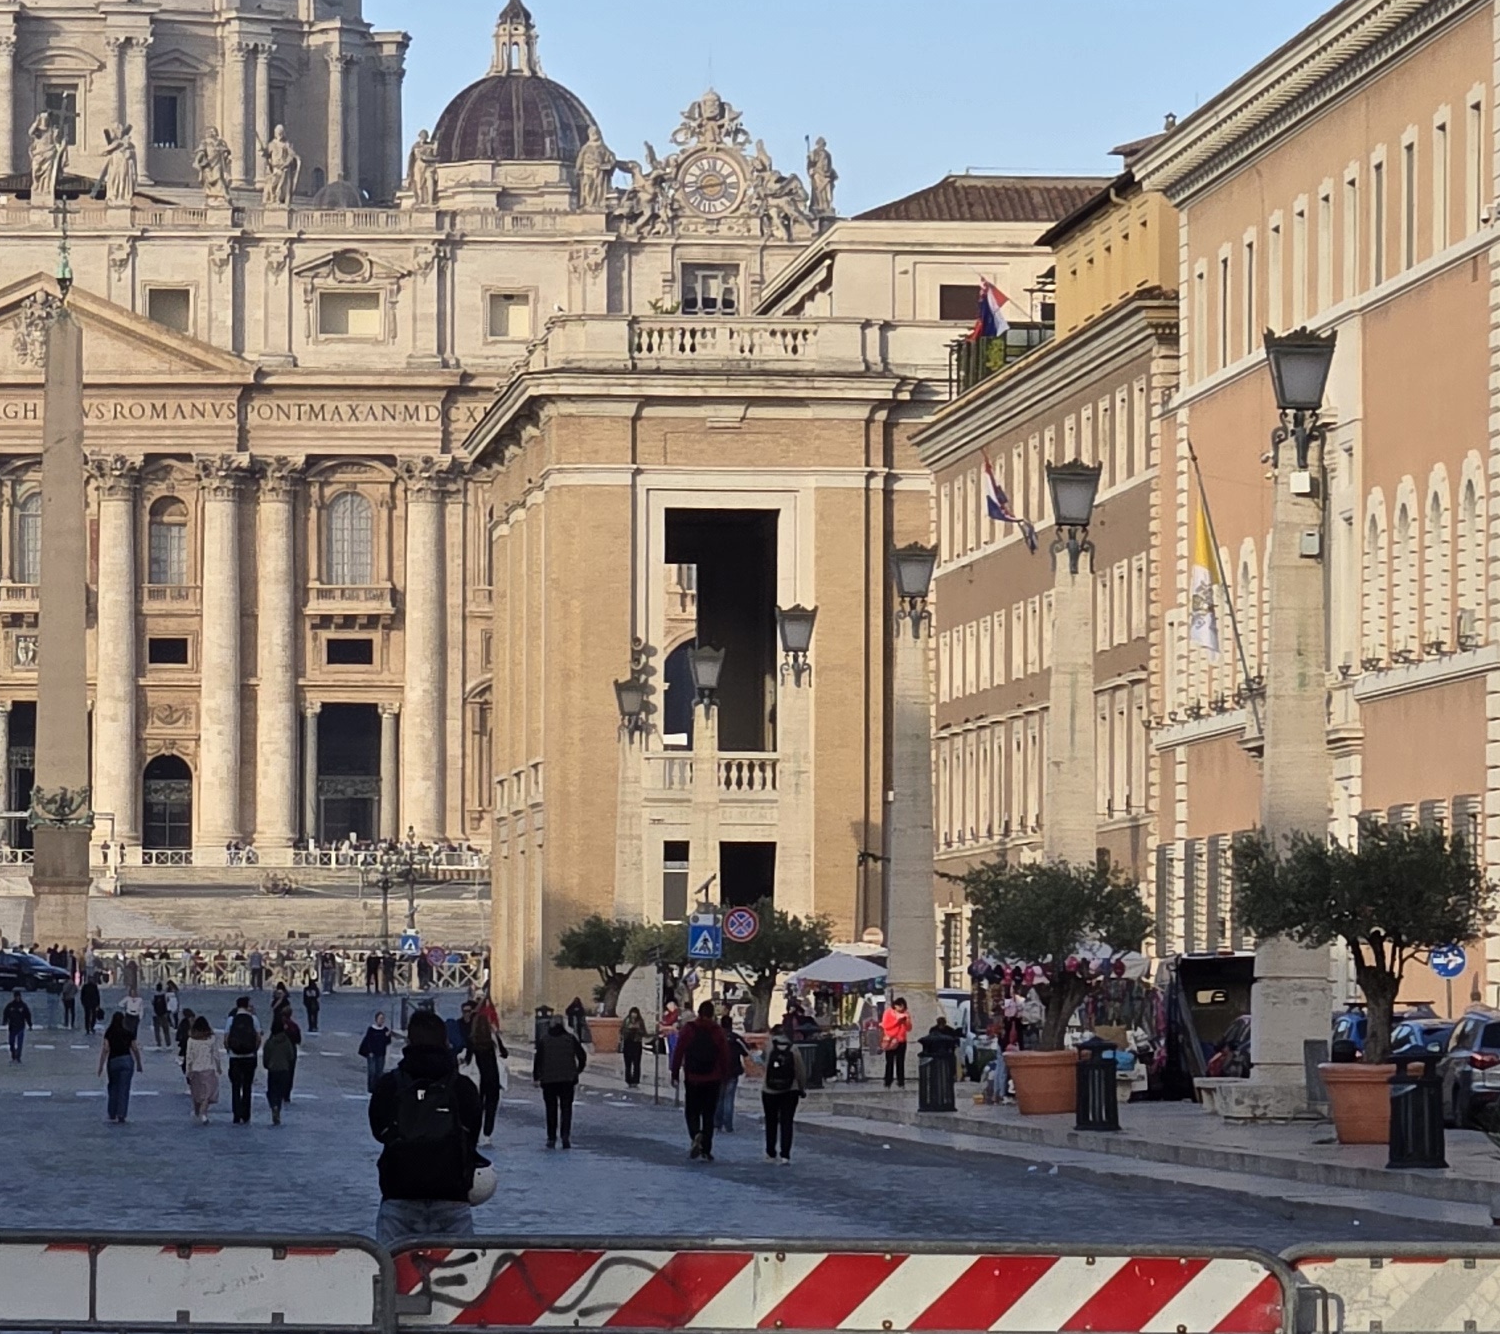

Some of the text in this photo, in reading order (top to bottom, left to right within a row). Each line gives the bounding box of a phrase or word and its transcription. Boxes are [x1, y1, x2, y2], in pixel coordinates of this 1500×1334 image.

[113, 401, 236, 420] ROMANVS
[245, 403, 306, 421] PONT
[307, 403, 360, 422] MAX
